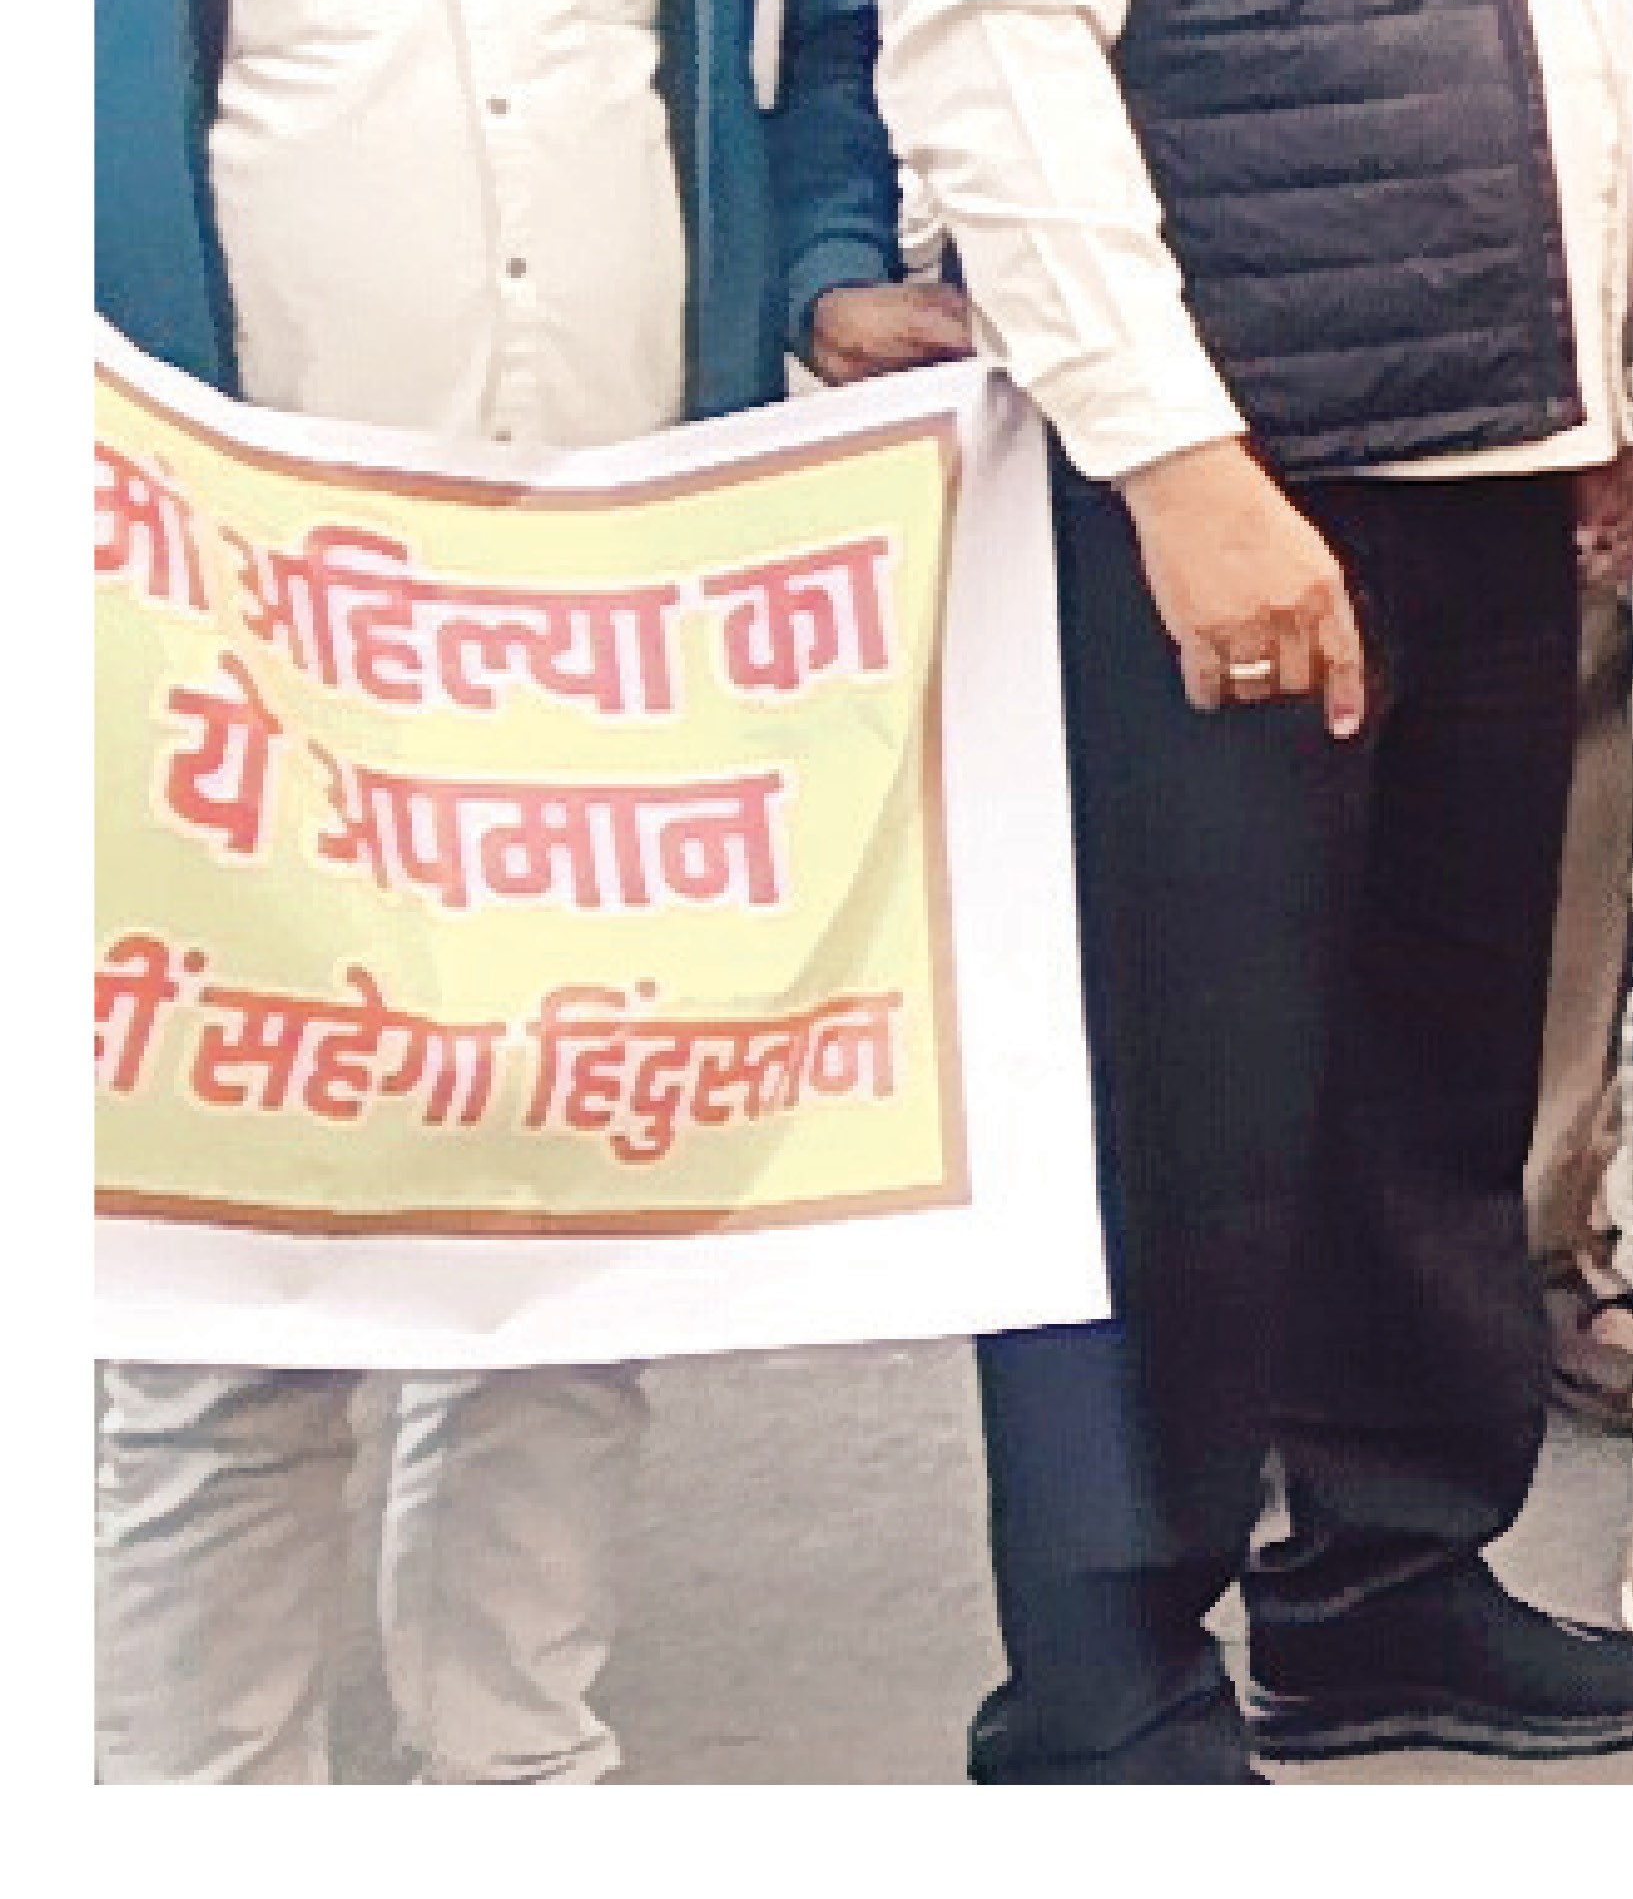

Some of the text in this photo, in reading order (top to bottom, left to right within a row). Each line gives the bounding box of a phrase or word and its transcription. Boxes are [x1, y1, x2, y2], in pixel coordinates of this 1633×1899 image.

[217, 524, 679, 710] अहिल्या
[704, 537, 889, 690] का
[166, 650, 783, 907] ये अपमान
[192, 965, 505, 1126] सहेगा
[525, 980, 902, 1164] हिंदुस्तान
